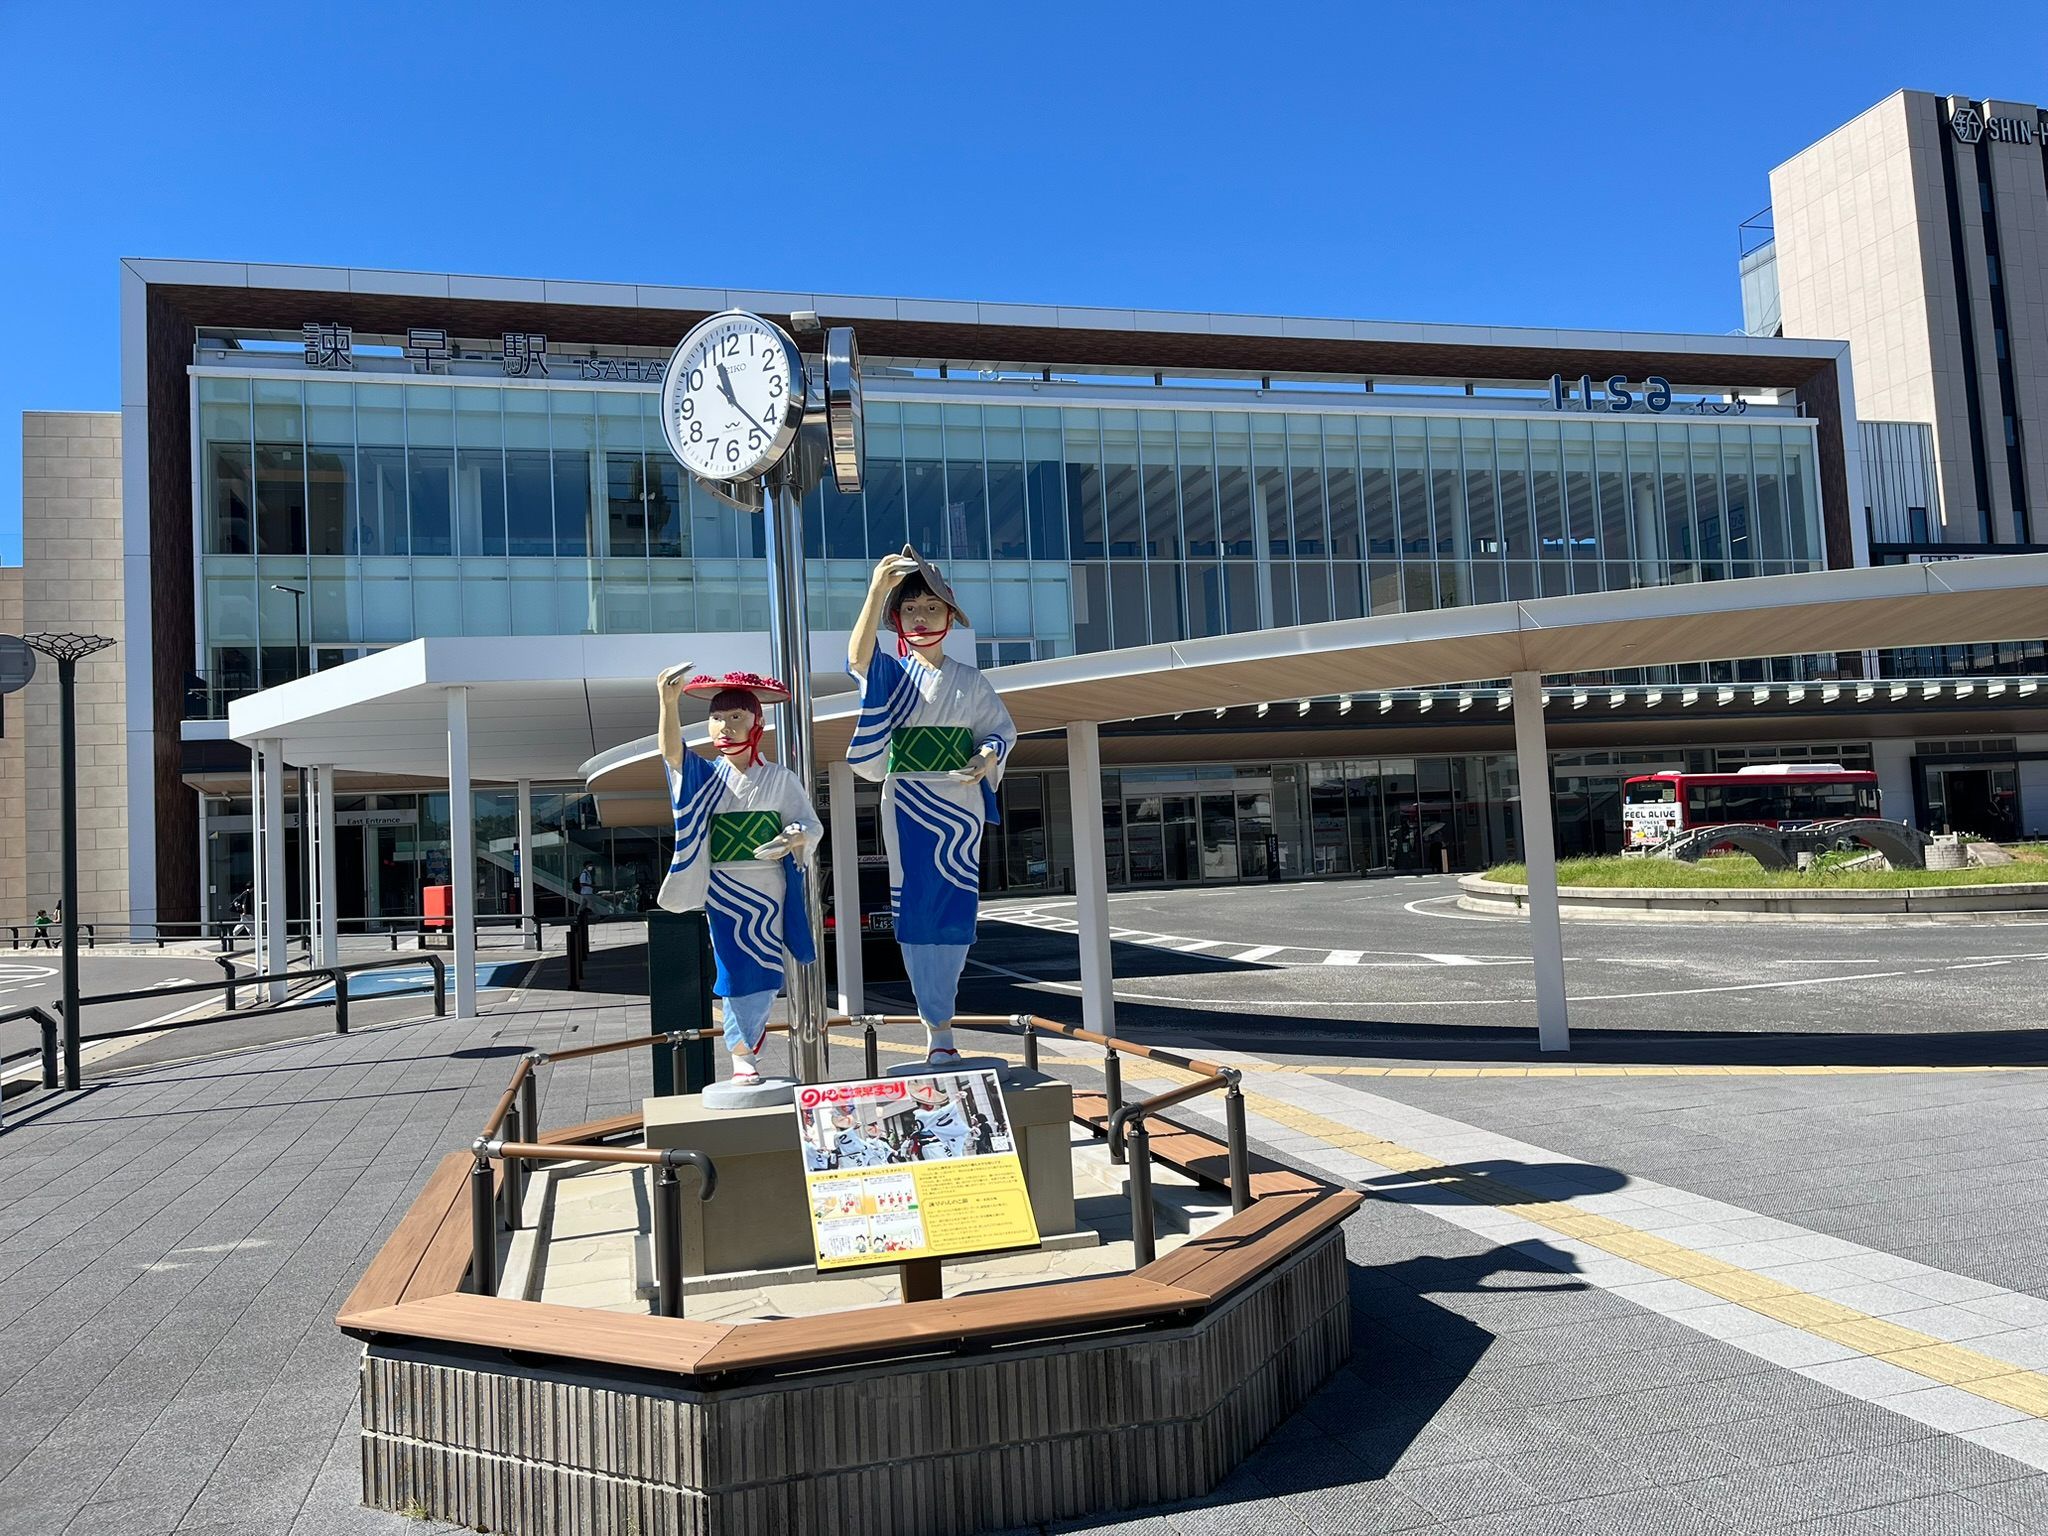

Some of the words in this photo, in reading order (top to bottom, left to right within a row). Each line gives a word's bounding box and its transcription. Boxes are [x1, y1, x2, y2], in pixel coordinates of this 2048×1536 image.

[302, 322, 550, 376] 諫早駅
[703, 345, 717, 369] 11
[721, 333, 741, 358] 12
[579, 359, 668, 381] ISAHA
[761, 348, 776, 372] 2
[685, 369, 704, 393] 10
[768, 374, 784, 398] 3
[681, 398, 696, 421] 9
[762, 403, 779, 425] 4
[689, 420, 704, 443] 8
[747, 428, 762, 450] 5
[706, 438, 720, 461] 7
[726, 439, 741, 463] 6
[365, 817, 401, 825] Entrance
[1648, 810, 1676, 818] ALIVE
